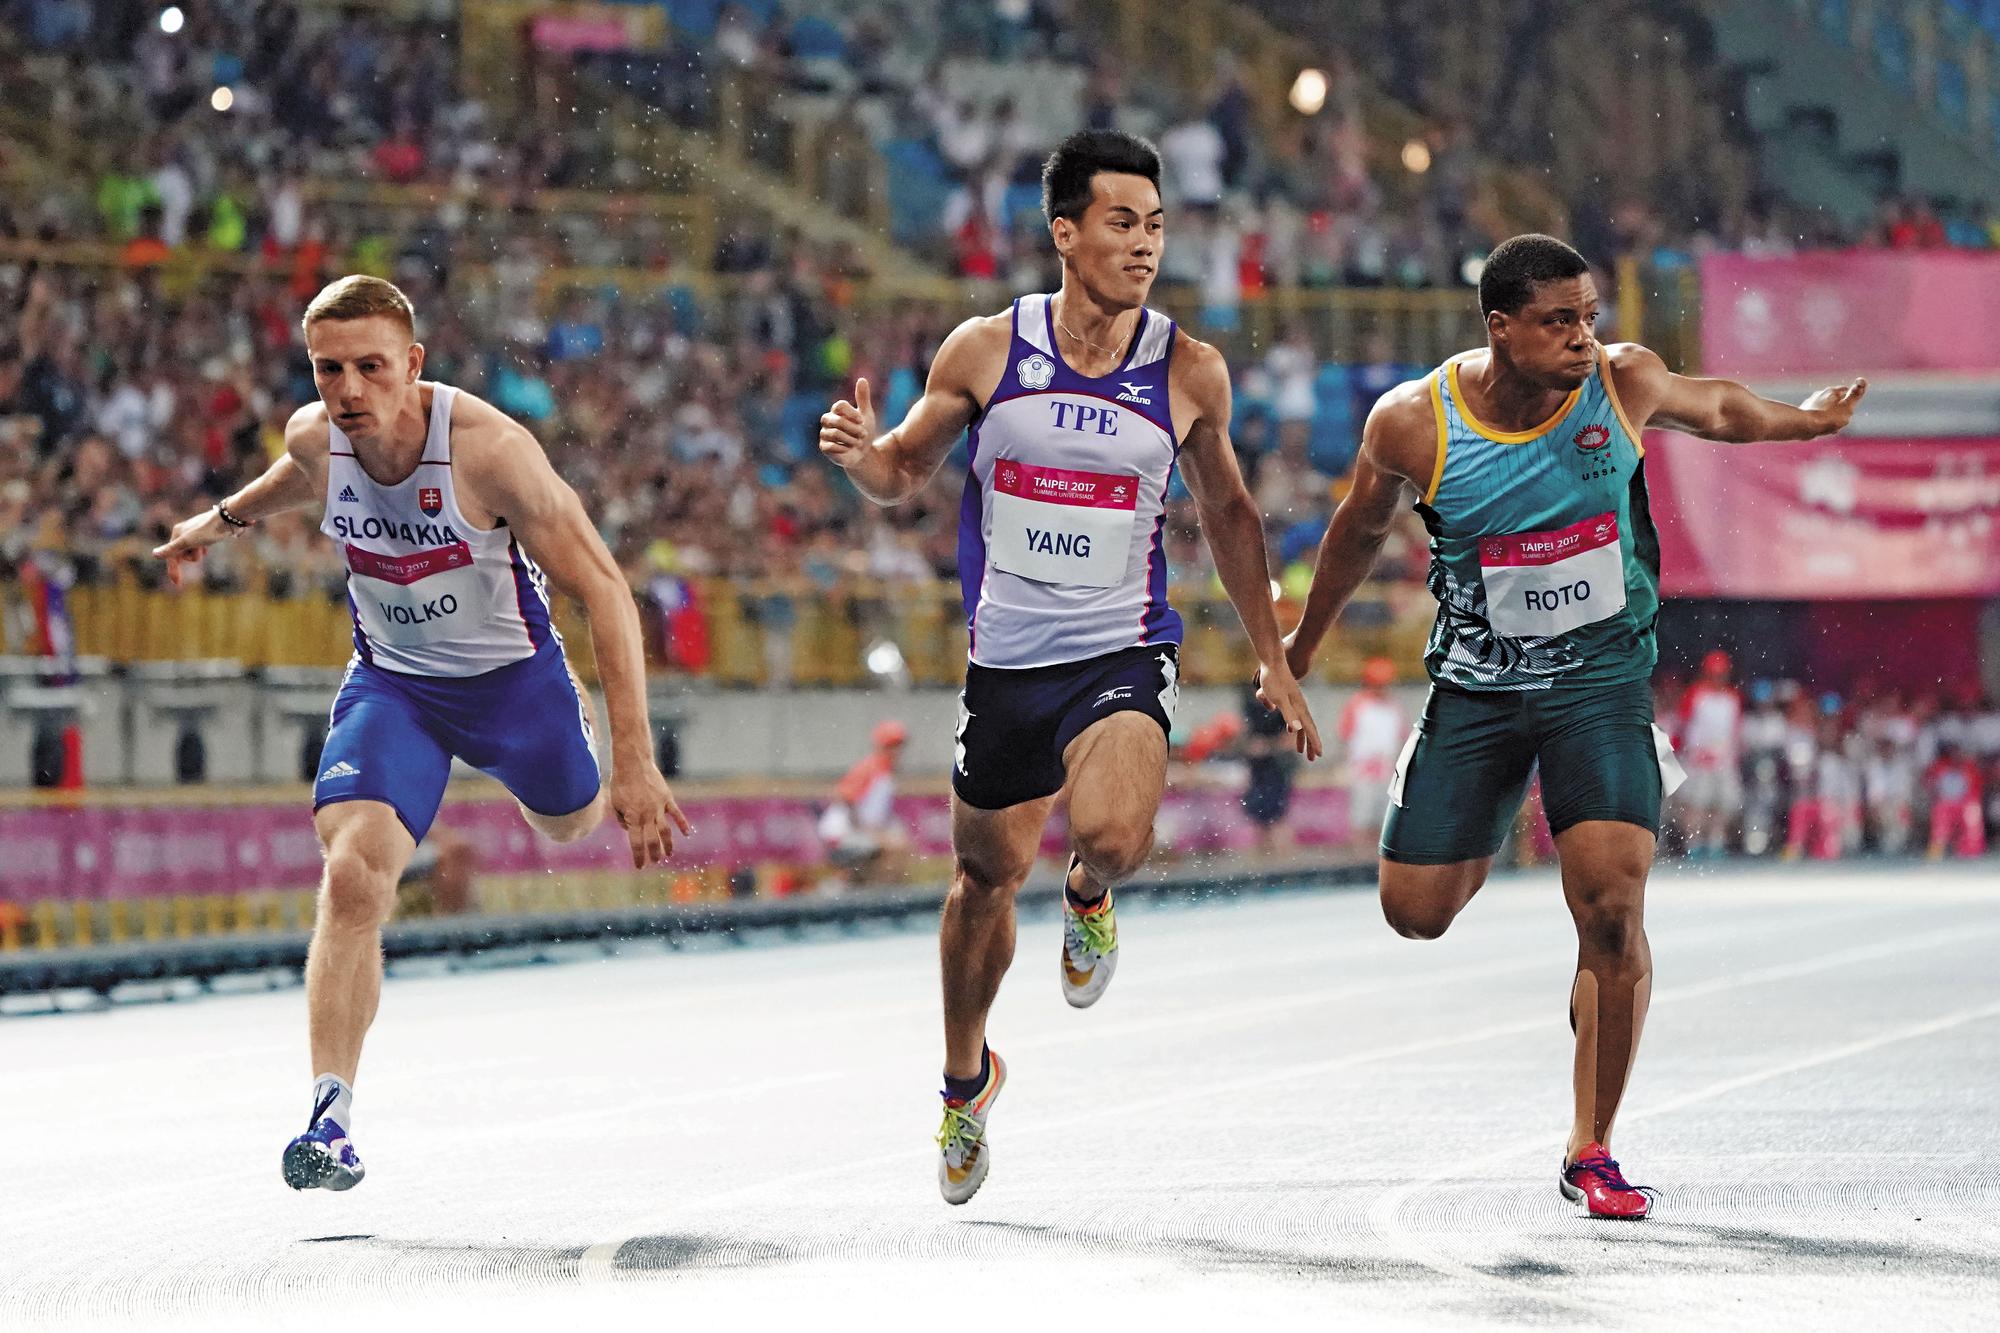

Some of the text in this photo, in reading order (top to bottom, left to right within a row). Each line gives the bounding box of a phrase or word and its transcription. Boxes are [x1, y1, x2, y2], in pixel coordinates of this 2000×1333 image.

[1050, 401, 1118, 436] TPE
[1582, 465, 1617, 480] USSA
[1033, 488, 1057, 498] SUMMER
[1034, 477, 1096, 493] TAIPEI 2017
[333, 515, 460, 546] SLOVAKIA
[1025, 528, 1091, 558] YANG
[1520, 534, 1580, 552] TAIPEI 2017
[406, 560, 430, 573] 2017
[1524, 580, 1591, 611] ROTO
[380, 594, 458, 625] VOLKO
